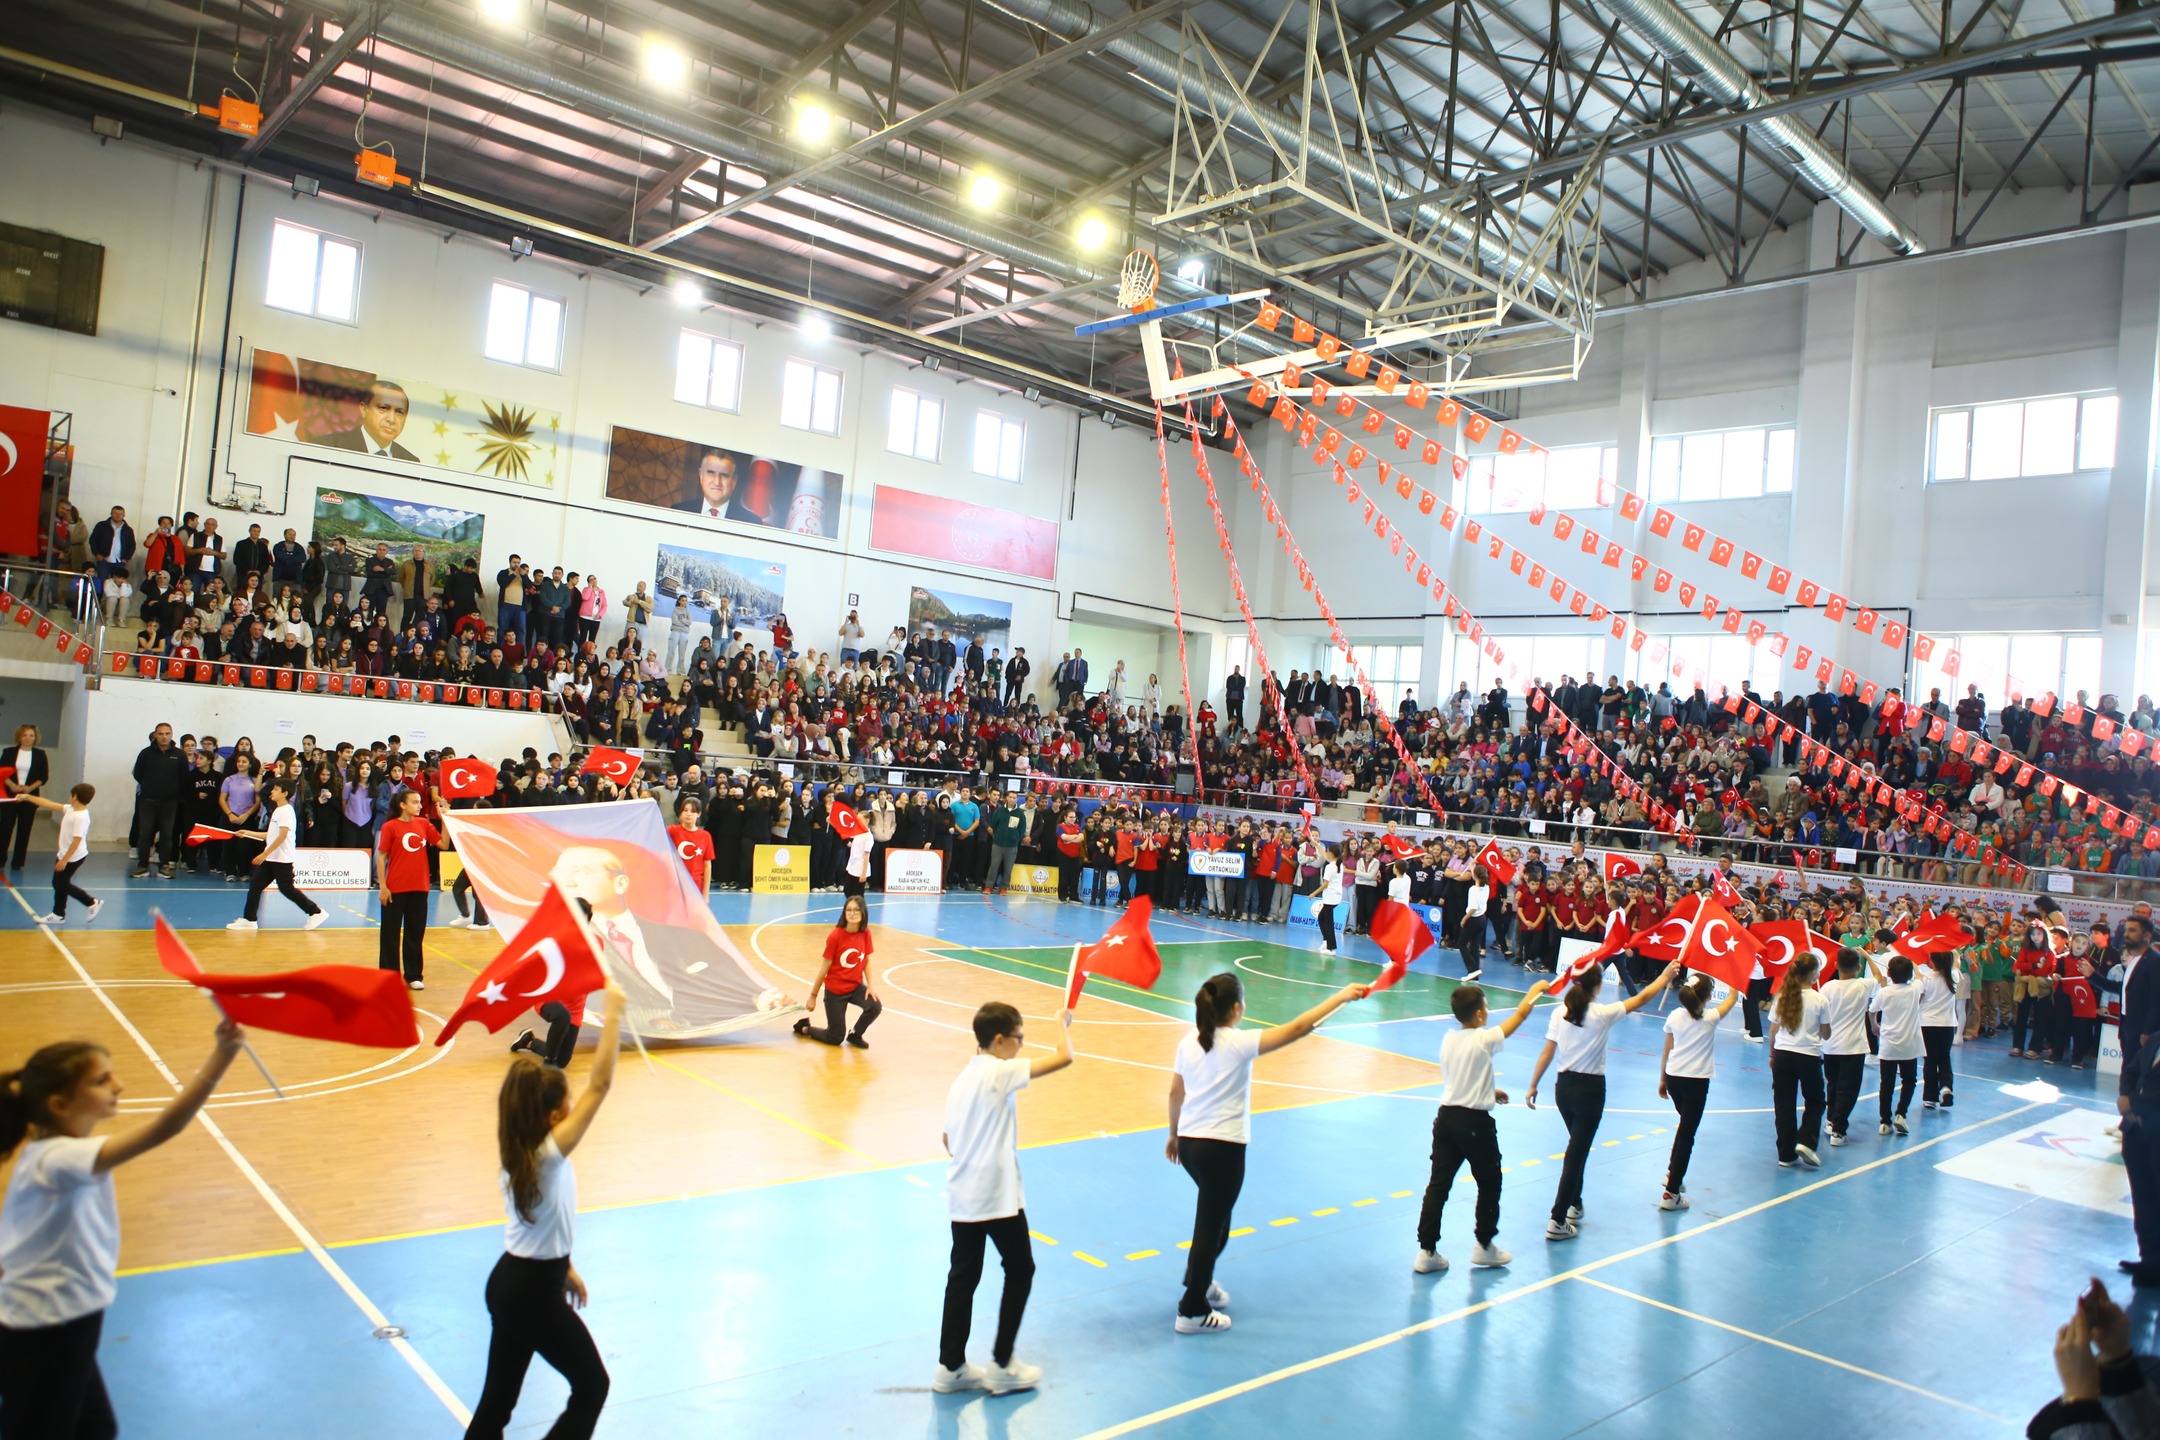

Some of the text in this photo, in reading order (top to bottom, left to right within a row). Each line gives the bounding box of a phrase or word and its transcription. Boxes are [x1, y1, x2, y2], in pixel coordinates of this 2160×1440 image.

[43, 251, 59, 260] GUEST
[16, 267, 31, 277] SCORE
[849, 594, 858, 606] B
[1208, 856, 1241, 865] YAVUZ SELİM
[1208, 865, 1240, 874] ORTAOKULU
